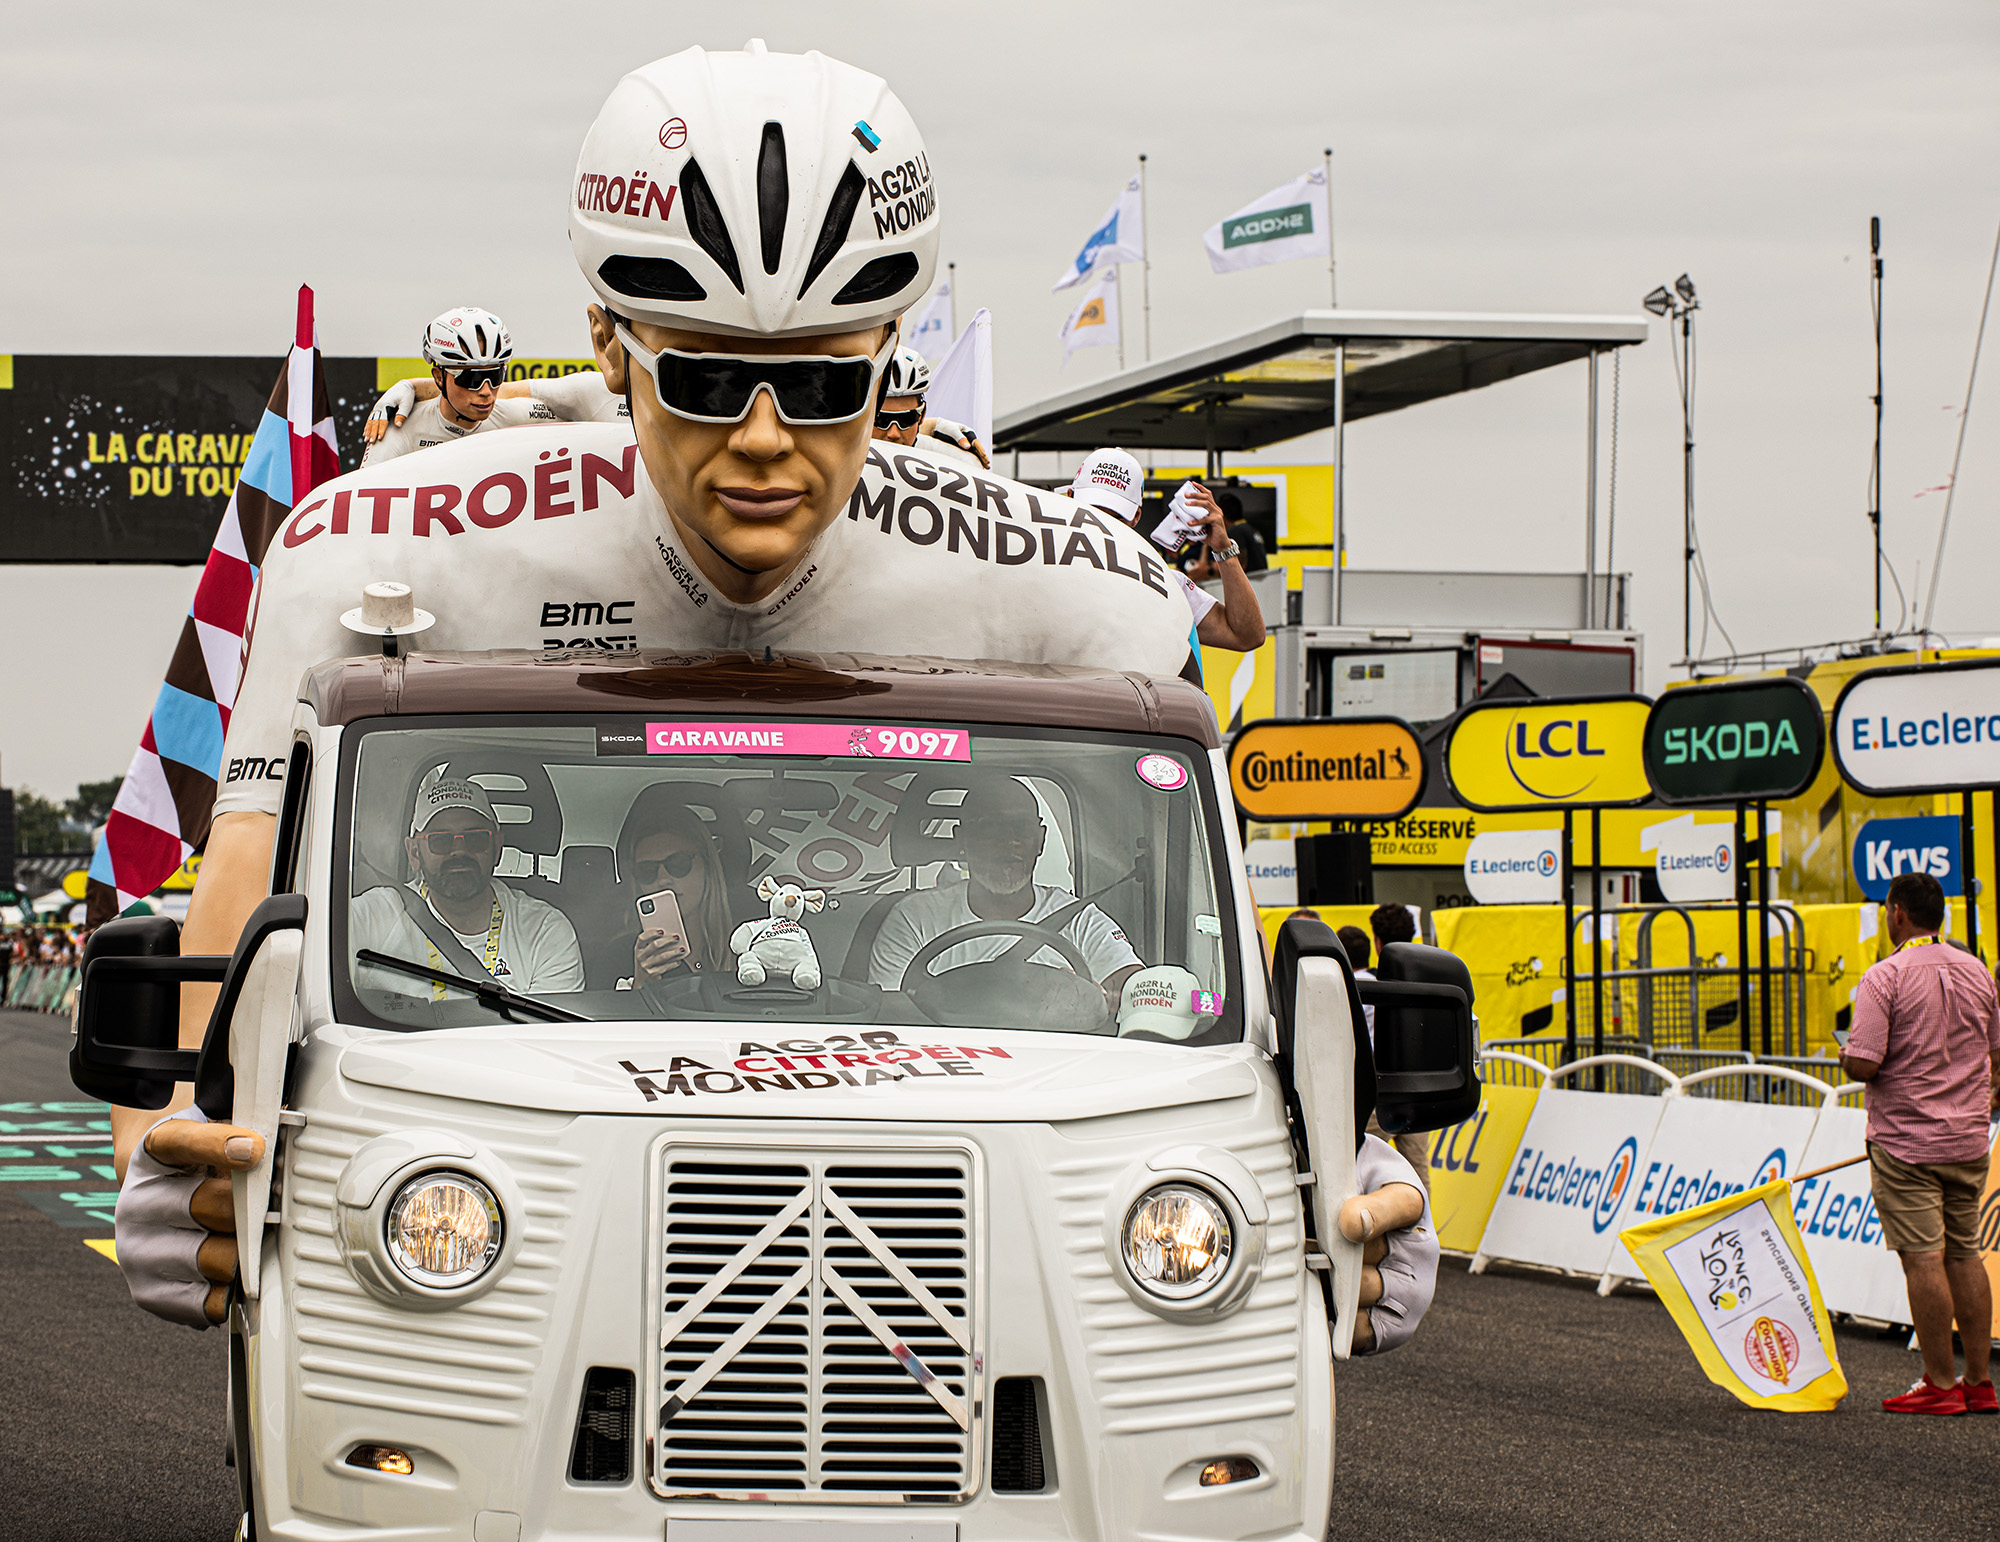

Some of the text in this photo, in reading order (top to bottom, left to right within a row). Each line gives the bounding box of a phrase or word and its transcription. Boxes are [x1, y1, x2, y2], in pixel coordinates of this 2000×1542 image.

[577, 170, 679, 221] CITROËN
[867, 160, 921, 208] AG2R
[433, 338, 455, 348] CITROËN
[88, 433, 128, 463] LA
[130, 466, 241, 497] DU TOU
[1091, 469, 1132, 485] MONDIALE
[1096, 462, 1130, 476] AG2R LA
[282, 444, 639, 549] CITROËN
[864, 446, 1114, 537] AG2R LA
[1091, 476, 1127, 491] CITROËN
[847, 475, 1169, 599] MONDIALE
[655, 535, 706, 608] MONDIALE
[666, 546, 709, 604] AG2R LA
[540, 601, 636, 628] BMC
[655, 730, 784, 747] CARAVANE
[877, 730, 959, 757] 9097
[1515, 720, 1605, 758] LCL
[1852, 712, 2000, 750] E.Leclerc
[226, 756, 286, 784] BMC
[1241, 748, 1387, 792] Continental
[427, 786, 474, 800] MONDIALE
[1395, 816, 1476, 839] RÉSERVÉ
[1399, 842, 1438, 856] ACCESS
[1660, 853, 1713, 871] E.Leclerc
[1866, 838, 1950, 881] Krys
[1245, 864, 1297, 878] E.Lecler
[1470, 858, 1535, 875] E.Leclerc
[1130, 988, 1177, 1000] MONDIALE
[1133, 980, 1173, 991] AG2R LA
[1132, 996, 1173, 1008] CITROËN
[1200, 1001, 1215, 1012] 22
[738, 1030, 910, 1057] AG2R
[617, 1056, 712, 1077] LA
[733, 1043, 1014, 1073] CITROËN
[632, 1060, 985, 1103] MONDIALE
[1507, 1148, 1601, 1209] E.Leclerc
